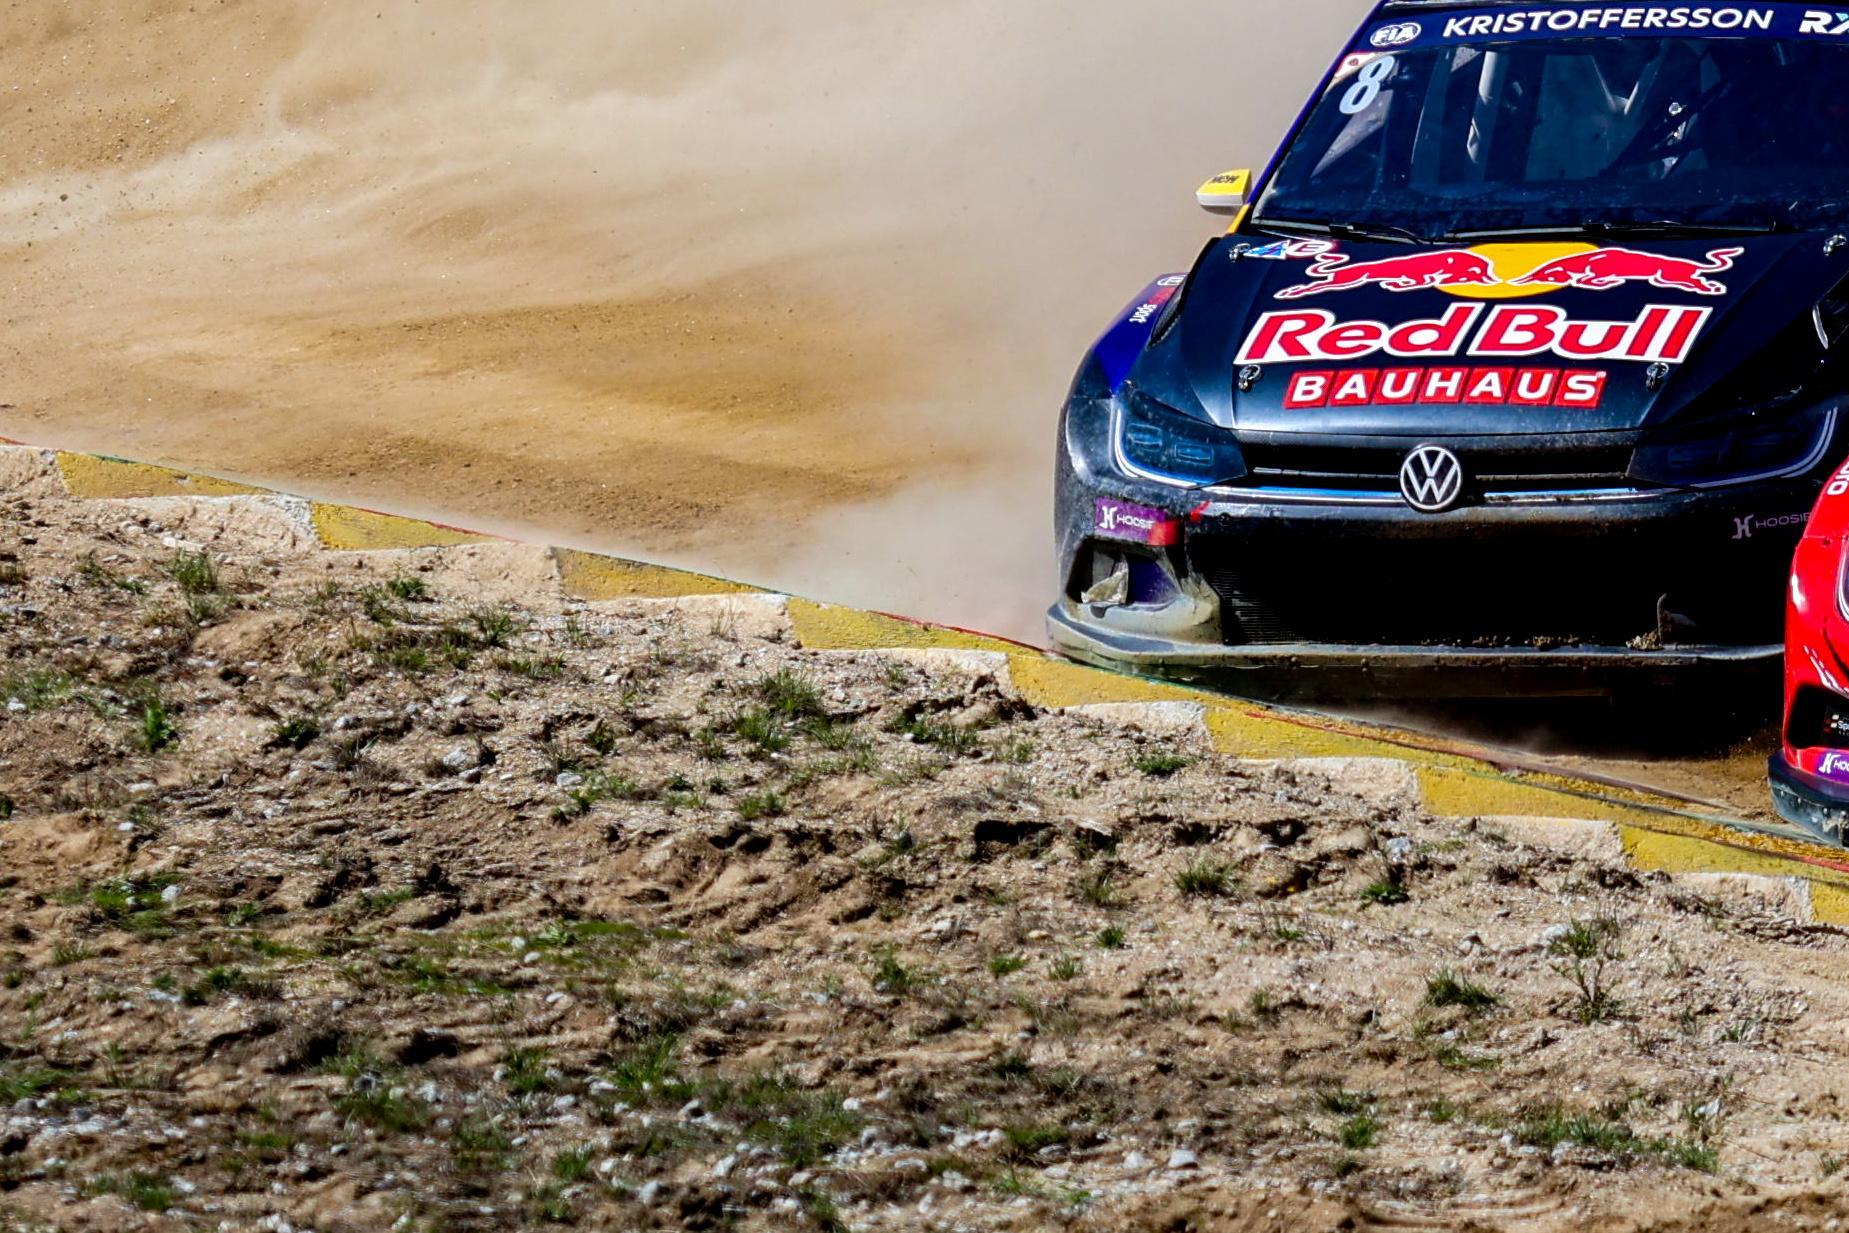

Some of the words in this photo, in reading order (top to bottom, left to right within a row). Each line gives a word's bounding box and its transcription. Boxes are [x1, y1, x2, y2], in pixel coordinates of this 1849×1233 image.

[1370, 22, 1422, 48] FIA
[1442, 7, 1774, 39] KRISTOFFERSSON
[1339, 55, 1396, 116] 8
[1235, 302, 1484, 365] Red
[1467, 302, 1713, 365] Bull
[1290, 369, 1598, 405] BAUHAUS
[1754, 511, 1813, 529] HOOSIE
